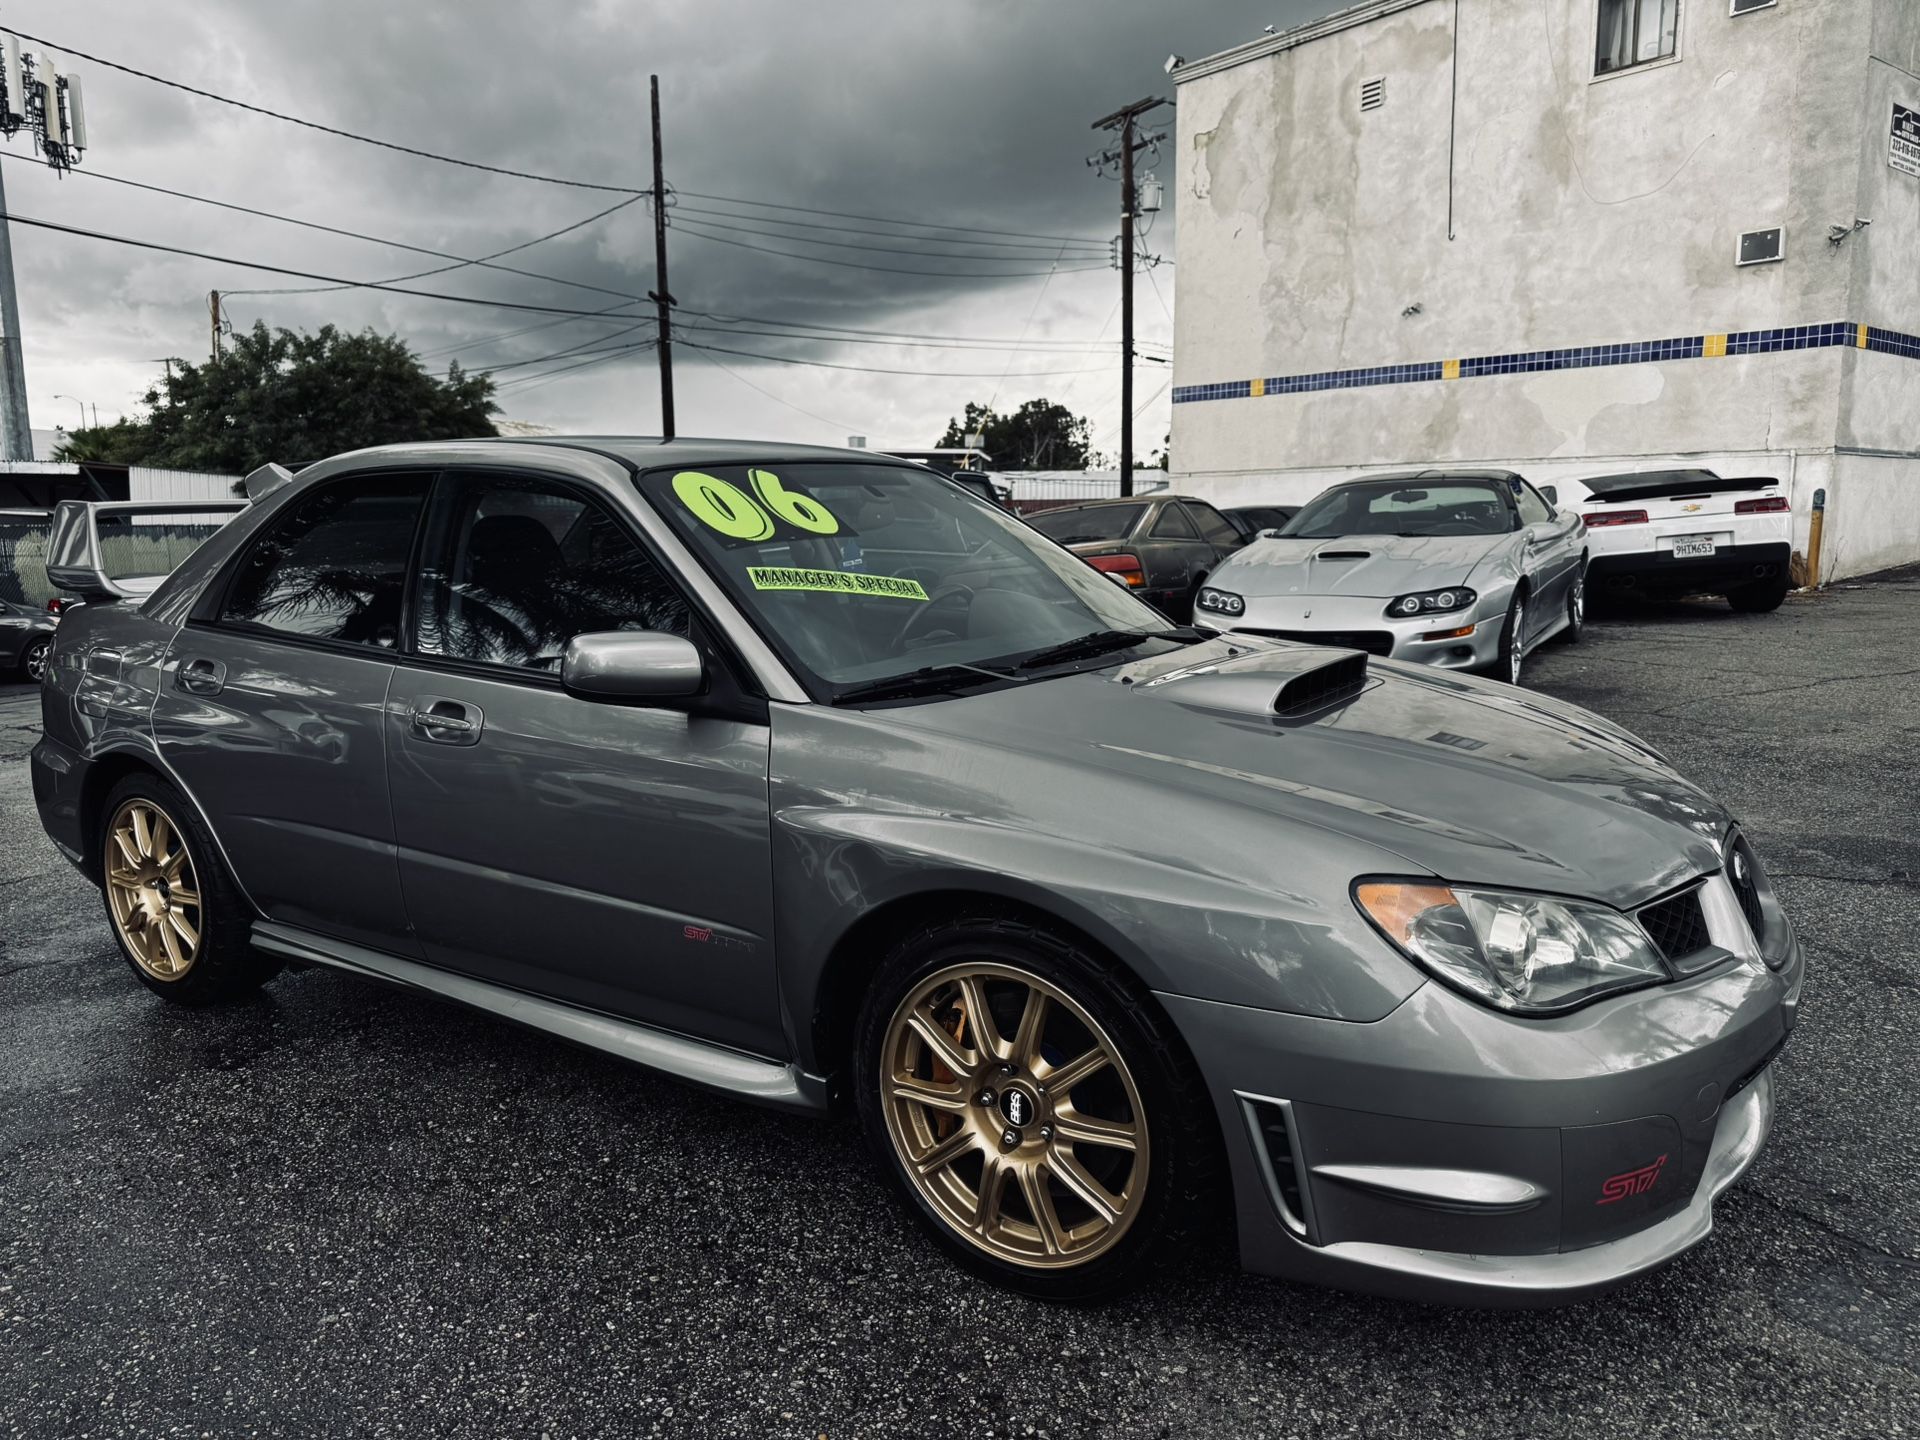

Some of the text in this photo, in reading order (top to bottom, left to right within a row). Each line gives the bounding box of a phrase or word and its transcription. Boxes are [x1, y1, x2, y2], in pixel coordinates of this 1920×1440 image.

[672, 468, 840, 541] 06
[753, 568, 922, 596] MANAGER'S SPECIAL
[1010, 1091, 1021, 1124] BBS
